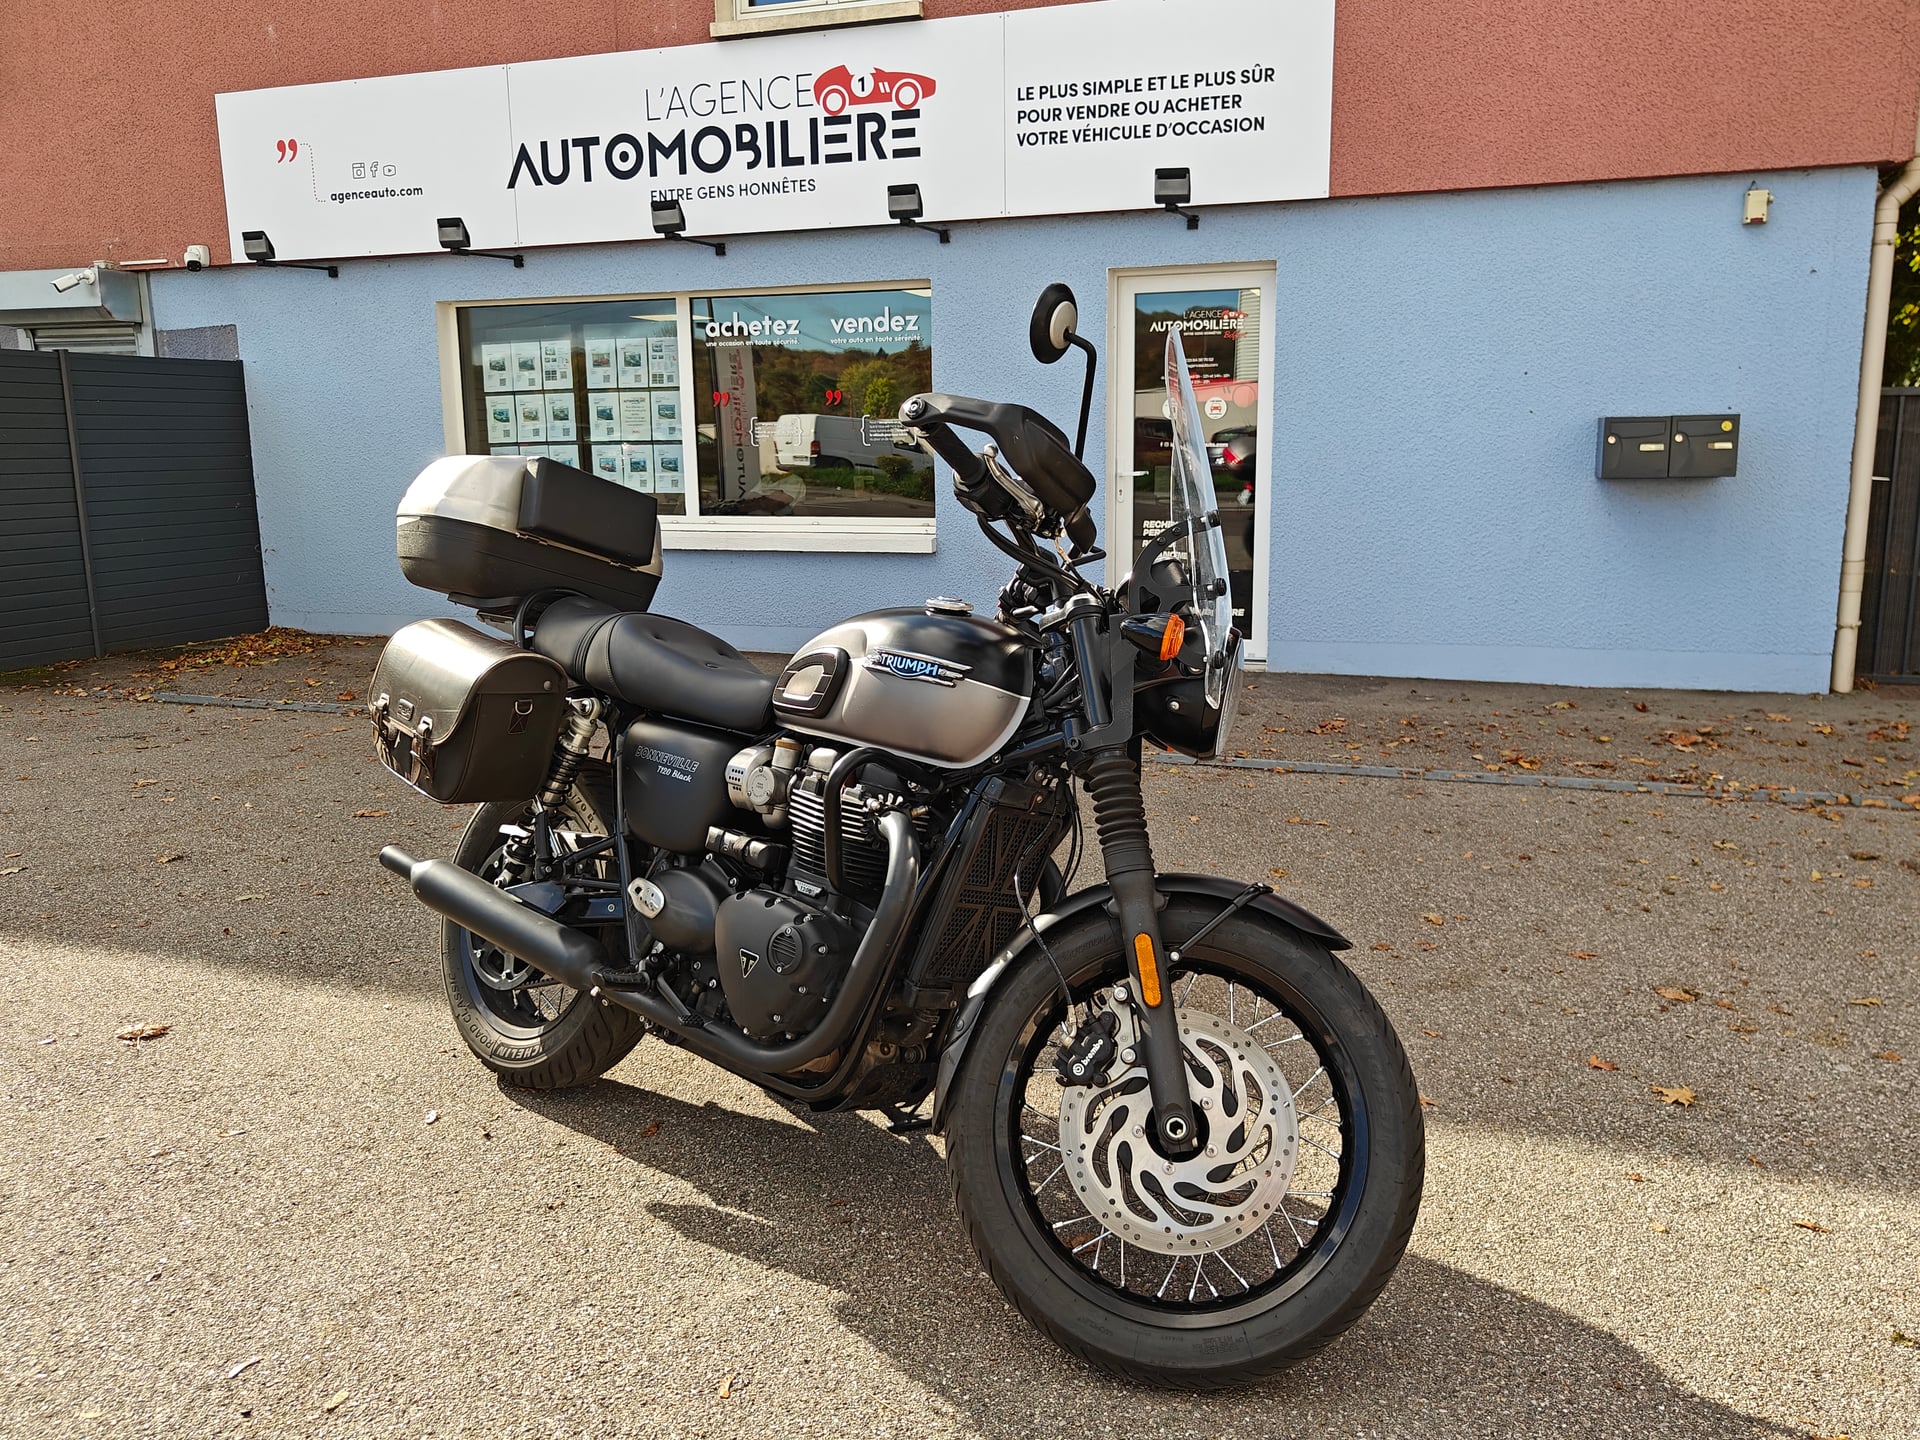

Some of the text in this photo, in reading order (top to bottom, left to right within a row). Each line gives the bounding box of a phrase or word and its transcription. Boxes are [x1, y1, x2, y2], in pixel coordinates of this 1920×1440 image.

[1017, 63, 1276, 102] LE PLUS SIMPLE ET LE PLUS SÛR
[645, 73, 814, 121] L'AGENCE
[1017, 94, 1243, 125] POUR VENDRE OU ACHETER
[1016, 116, 1266, 147] VOTRE VÉHICULE D'OCCASION
[330, 185, 424, 204] agenceauto.com
[650, 176, 817, 201] ENTRE GENS HONNÊTES
[705, 311, 800, 338] achetez
[830, 306, 919, 334] vendez
[719, 339, 745, 347] occasion
[830, 337, 847, 345] votre
[881, 653, 938, 676] TRIUMPH
[635, 745, 700, 773] BONNEVILLE
[656, 765, 693, 783] T120 Black
[448, 973, 495, 1049] ROAD CLASSIC
[496, 1040, 551, 1060] ICHELIN
[1081, 1038, 1104, 1066] brembo
